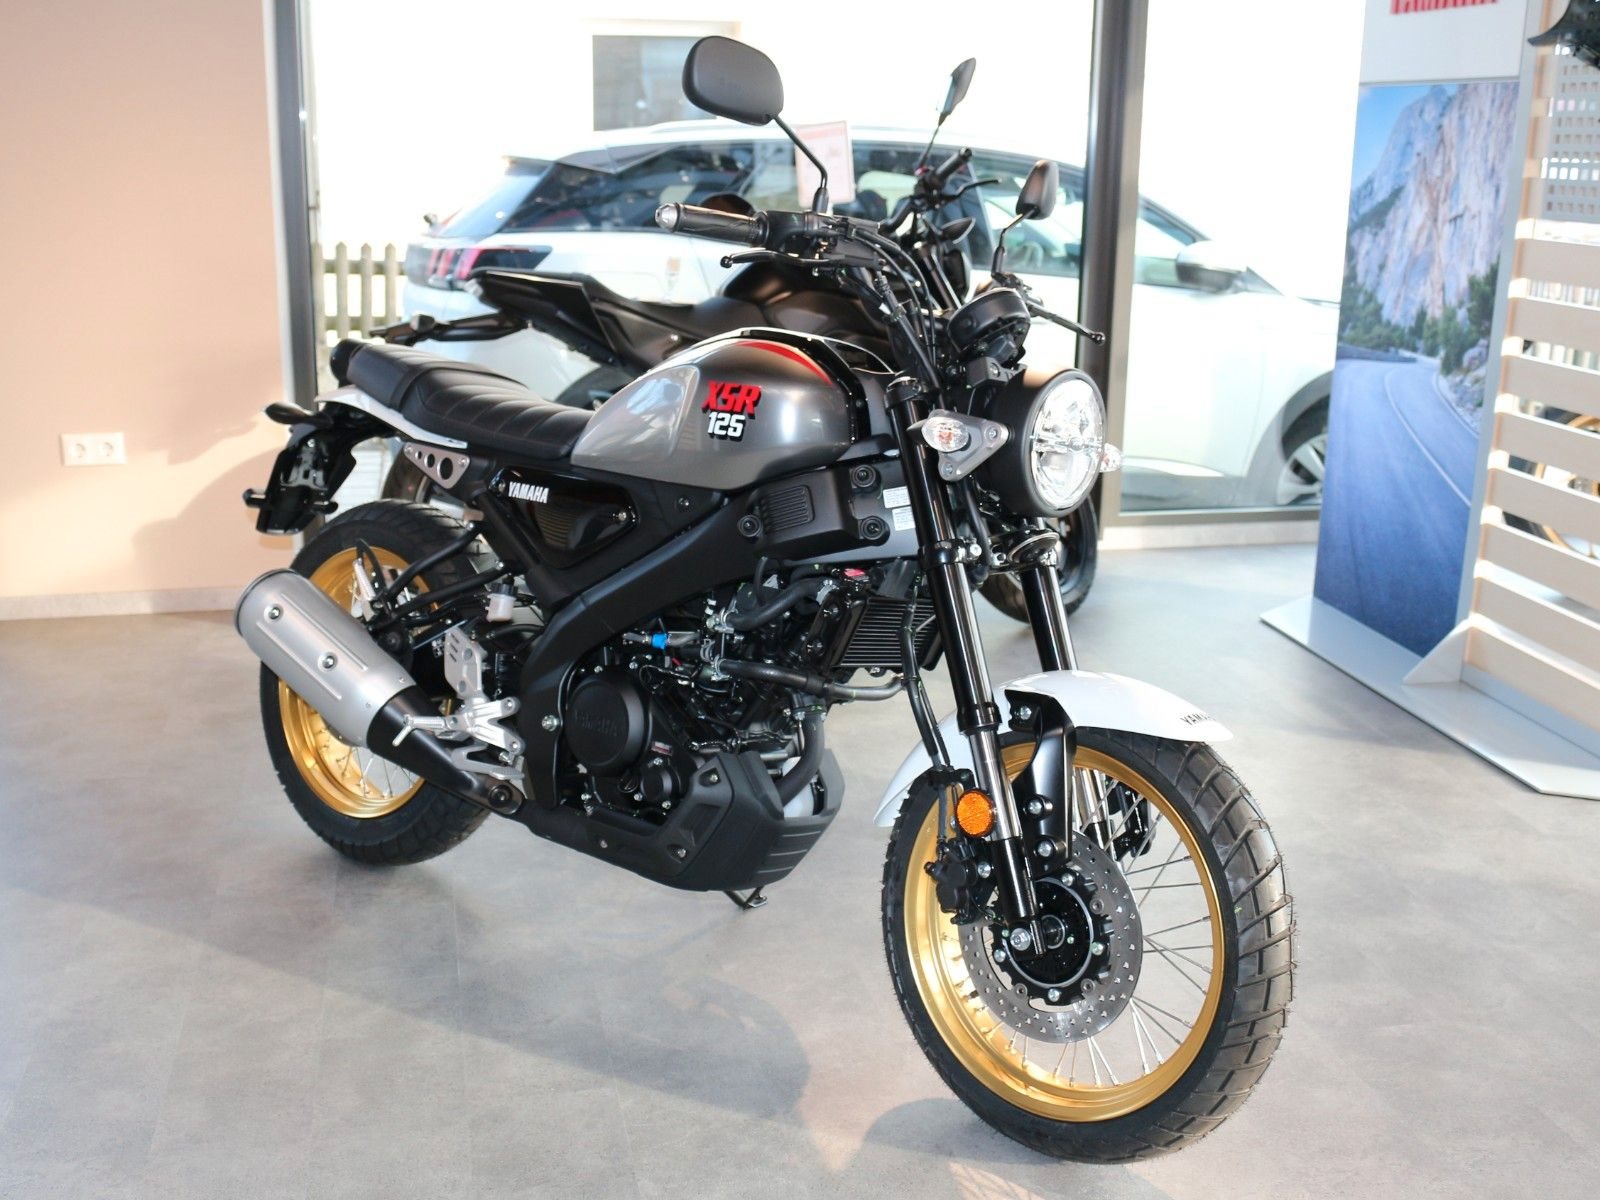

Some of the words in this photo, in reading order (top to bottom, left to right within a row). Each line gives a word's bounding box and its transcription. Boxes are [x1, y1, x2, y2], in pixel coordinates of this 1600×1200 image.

[702, 381, 762, 418] XSR
[707, 411, 746, 440] 125
[508, 481, 550, 504] YAMAHA
